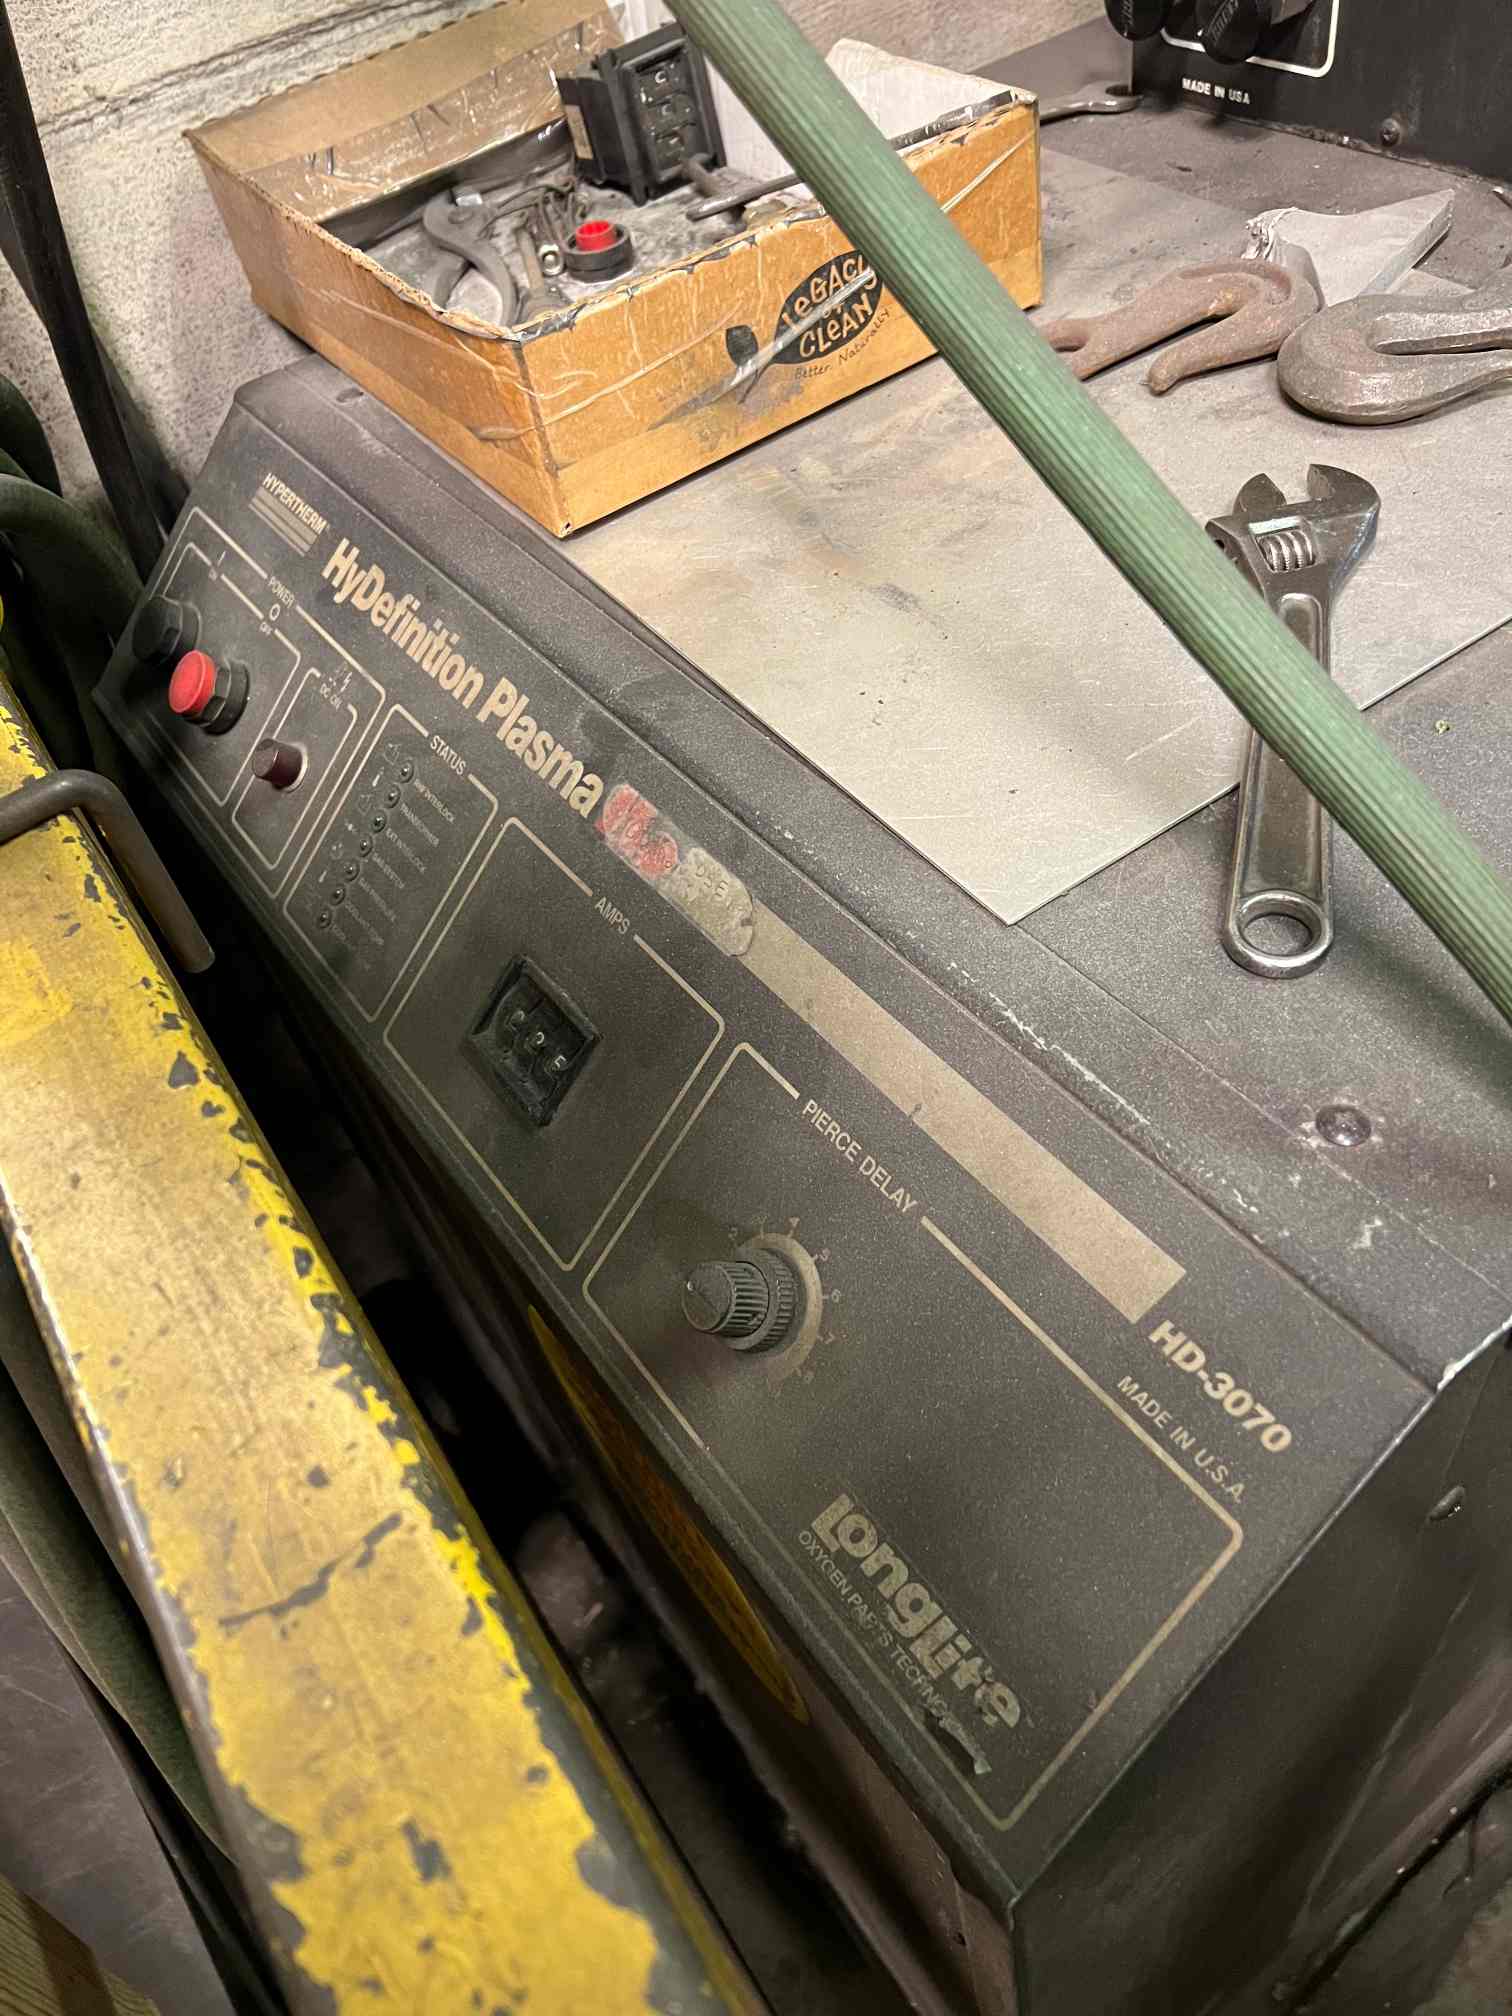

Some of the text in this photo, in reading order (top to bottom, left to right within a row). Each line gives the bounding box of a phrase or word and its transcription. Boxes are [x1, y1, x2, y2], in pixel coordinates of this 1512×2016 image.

[1182, 77, 1250, 104] MADE IN USA
[262, 472, 327, 534] HYPERTHERM
[267, 576, 297, 609] POWER
[321, 537, 604, 818] HyDefinition Plasma
[429, 735, 467, 776] STATUS
[594, 897, 630, 935] AMPS
[802, 1099, 918, 1213] PIERCE DELAY
[1117, 1375, 1173, 1429] MADE
[1169, 1426, 1196, 1450] IN
[1148, 1319, 1292, 1453] HD-3070
[799, 1530, 849, 1596] OXYGEN
